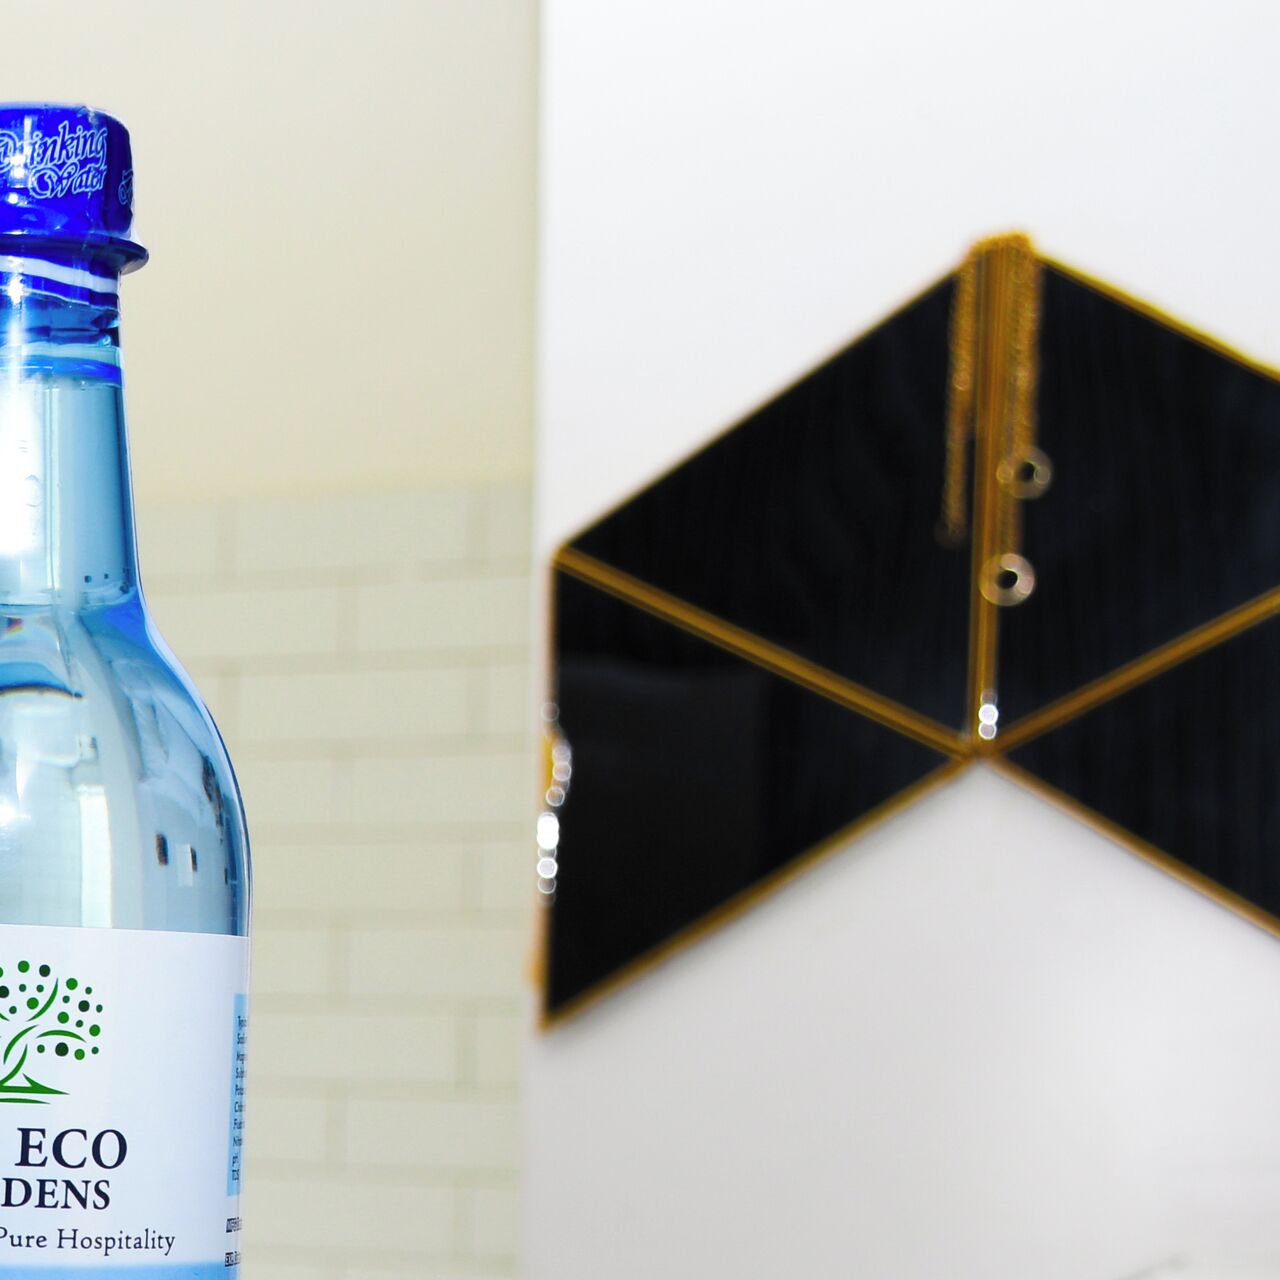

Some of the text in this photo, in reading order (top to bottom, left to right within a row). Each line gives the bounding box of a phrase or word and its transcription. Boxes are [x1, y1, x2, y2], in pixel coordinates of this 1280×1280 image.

[28, 162, 107, 199] Water
[15, 1127, 128, 1170] ECO
[57, 1228, 176, 1257] Hospitality
